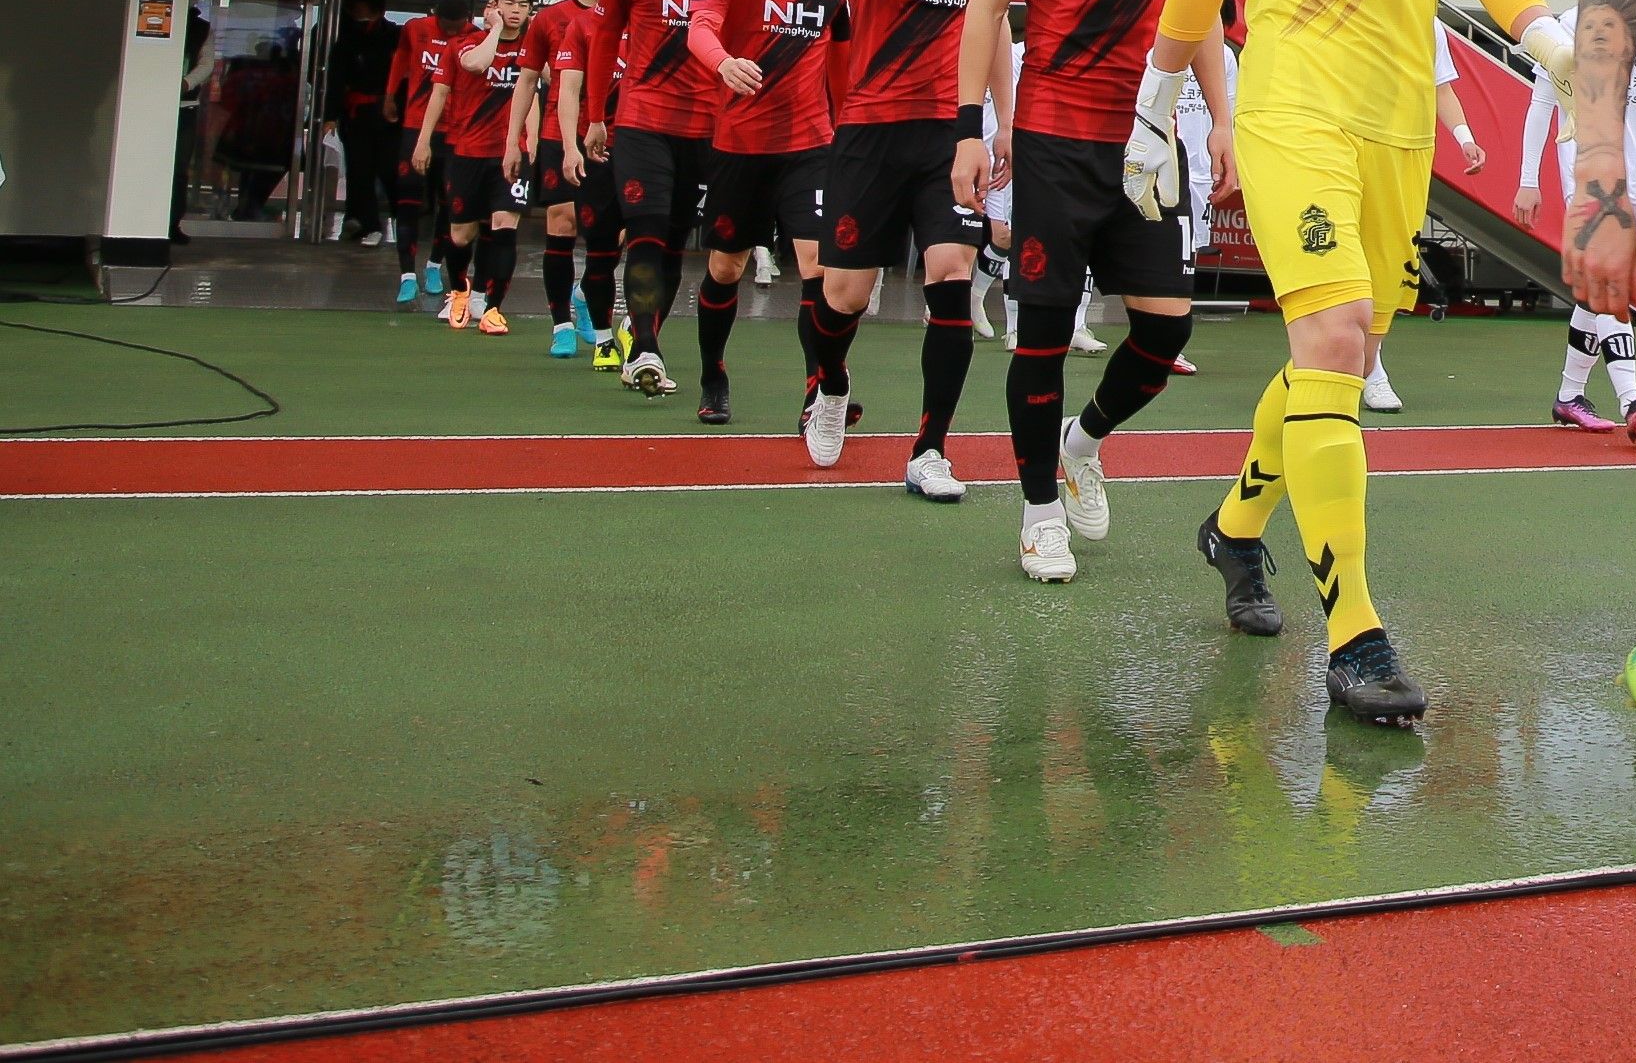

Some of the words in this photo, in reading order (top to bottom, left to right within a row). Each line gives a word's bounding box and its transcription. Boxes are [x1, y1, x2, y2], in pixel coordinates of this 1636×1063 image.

[763, 0, 825, 27] NH
[770, 25, 821, 38] NongHyup
[1211, 231, 1241, 245] BALL
